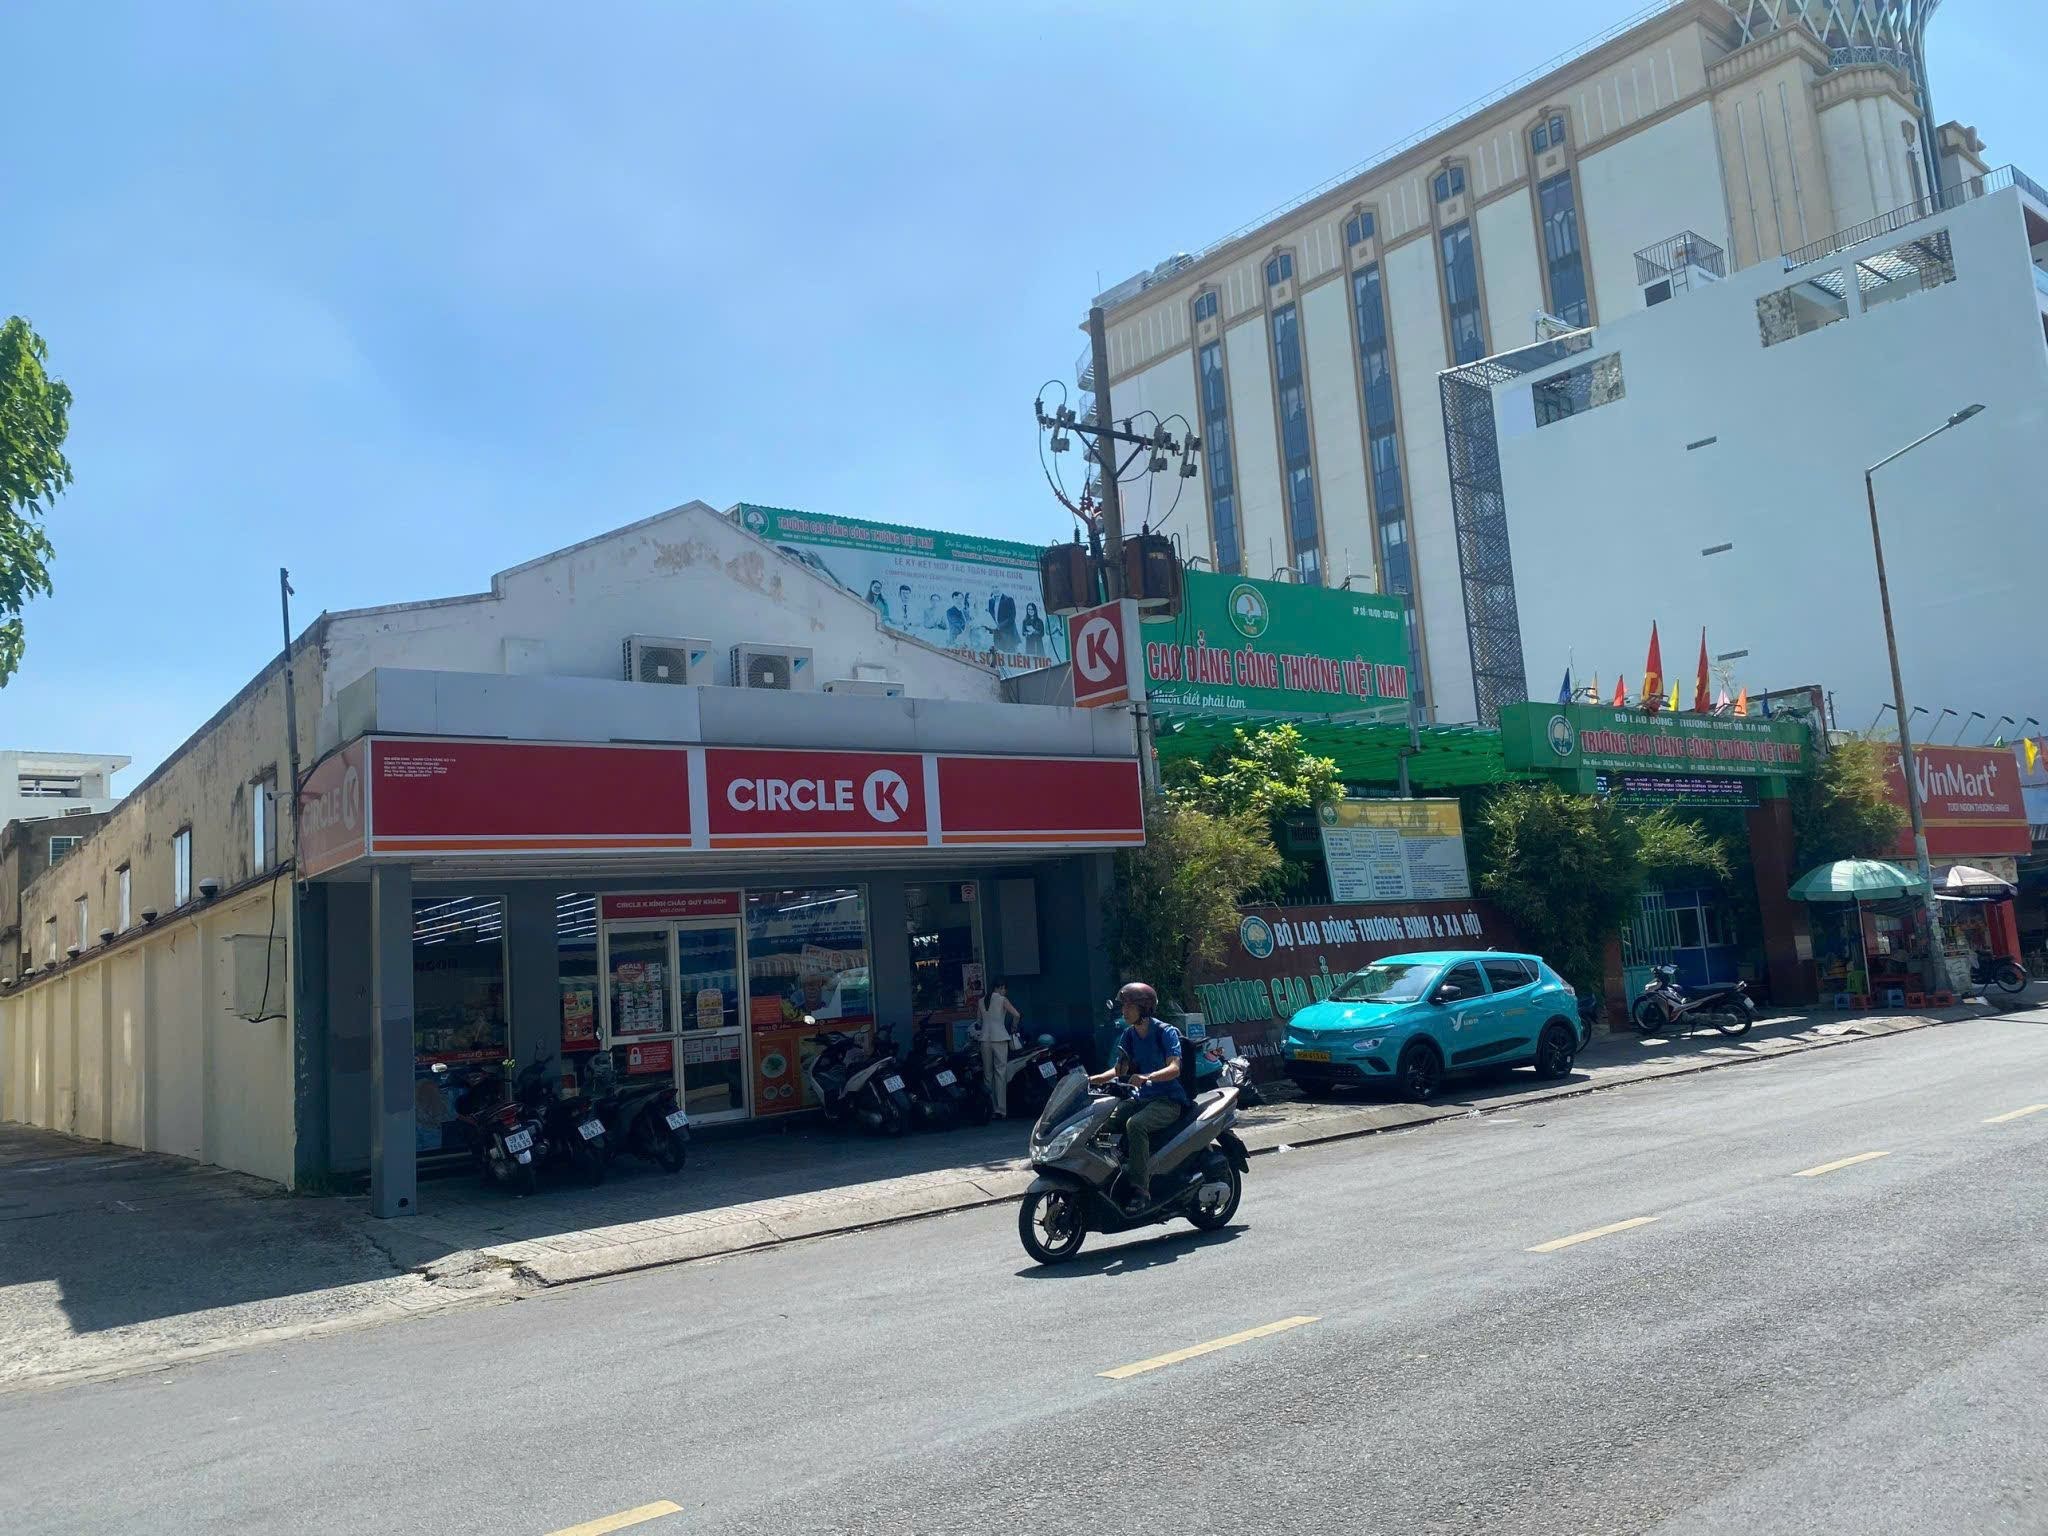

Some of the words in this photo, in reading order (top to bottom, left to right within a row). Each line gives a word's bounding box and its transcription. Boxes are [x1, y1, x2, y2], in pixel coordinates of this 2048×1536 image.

[1007, 652, 1030, 668] LIÊN
[1147, 641, 1183, 681] CAO
[1184, 630, 1233, 685] ĐẲNG
[1235, 643, 1280, 689] CÔNG
[1280, 653, 1343, 694] THƯƠNG
[1341, 655, 1374, 701] VIỆT
[1375, 664, 1408, 699] NAM
[1182, 688, 1201, 706] biết
[1201, 694, 1225, 711] phải
[1226, 695, 1247, 709] làm
[1628, 733, 1652, 756] CAO
[726, 778, 855, 812] CIRCLE
[1273, 917, 1294, 951] BỘ
[1294, 921, 1321, 946] LAO
[1403, 915, 1434, 939] BINH
[1434, 915, 1445, 938] &
[1461, 908, 1484, 940] HỘI
[1271, 976, 1311, 1019] CAO
